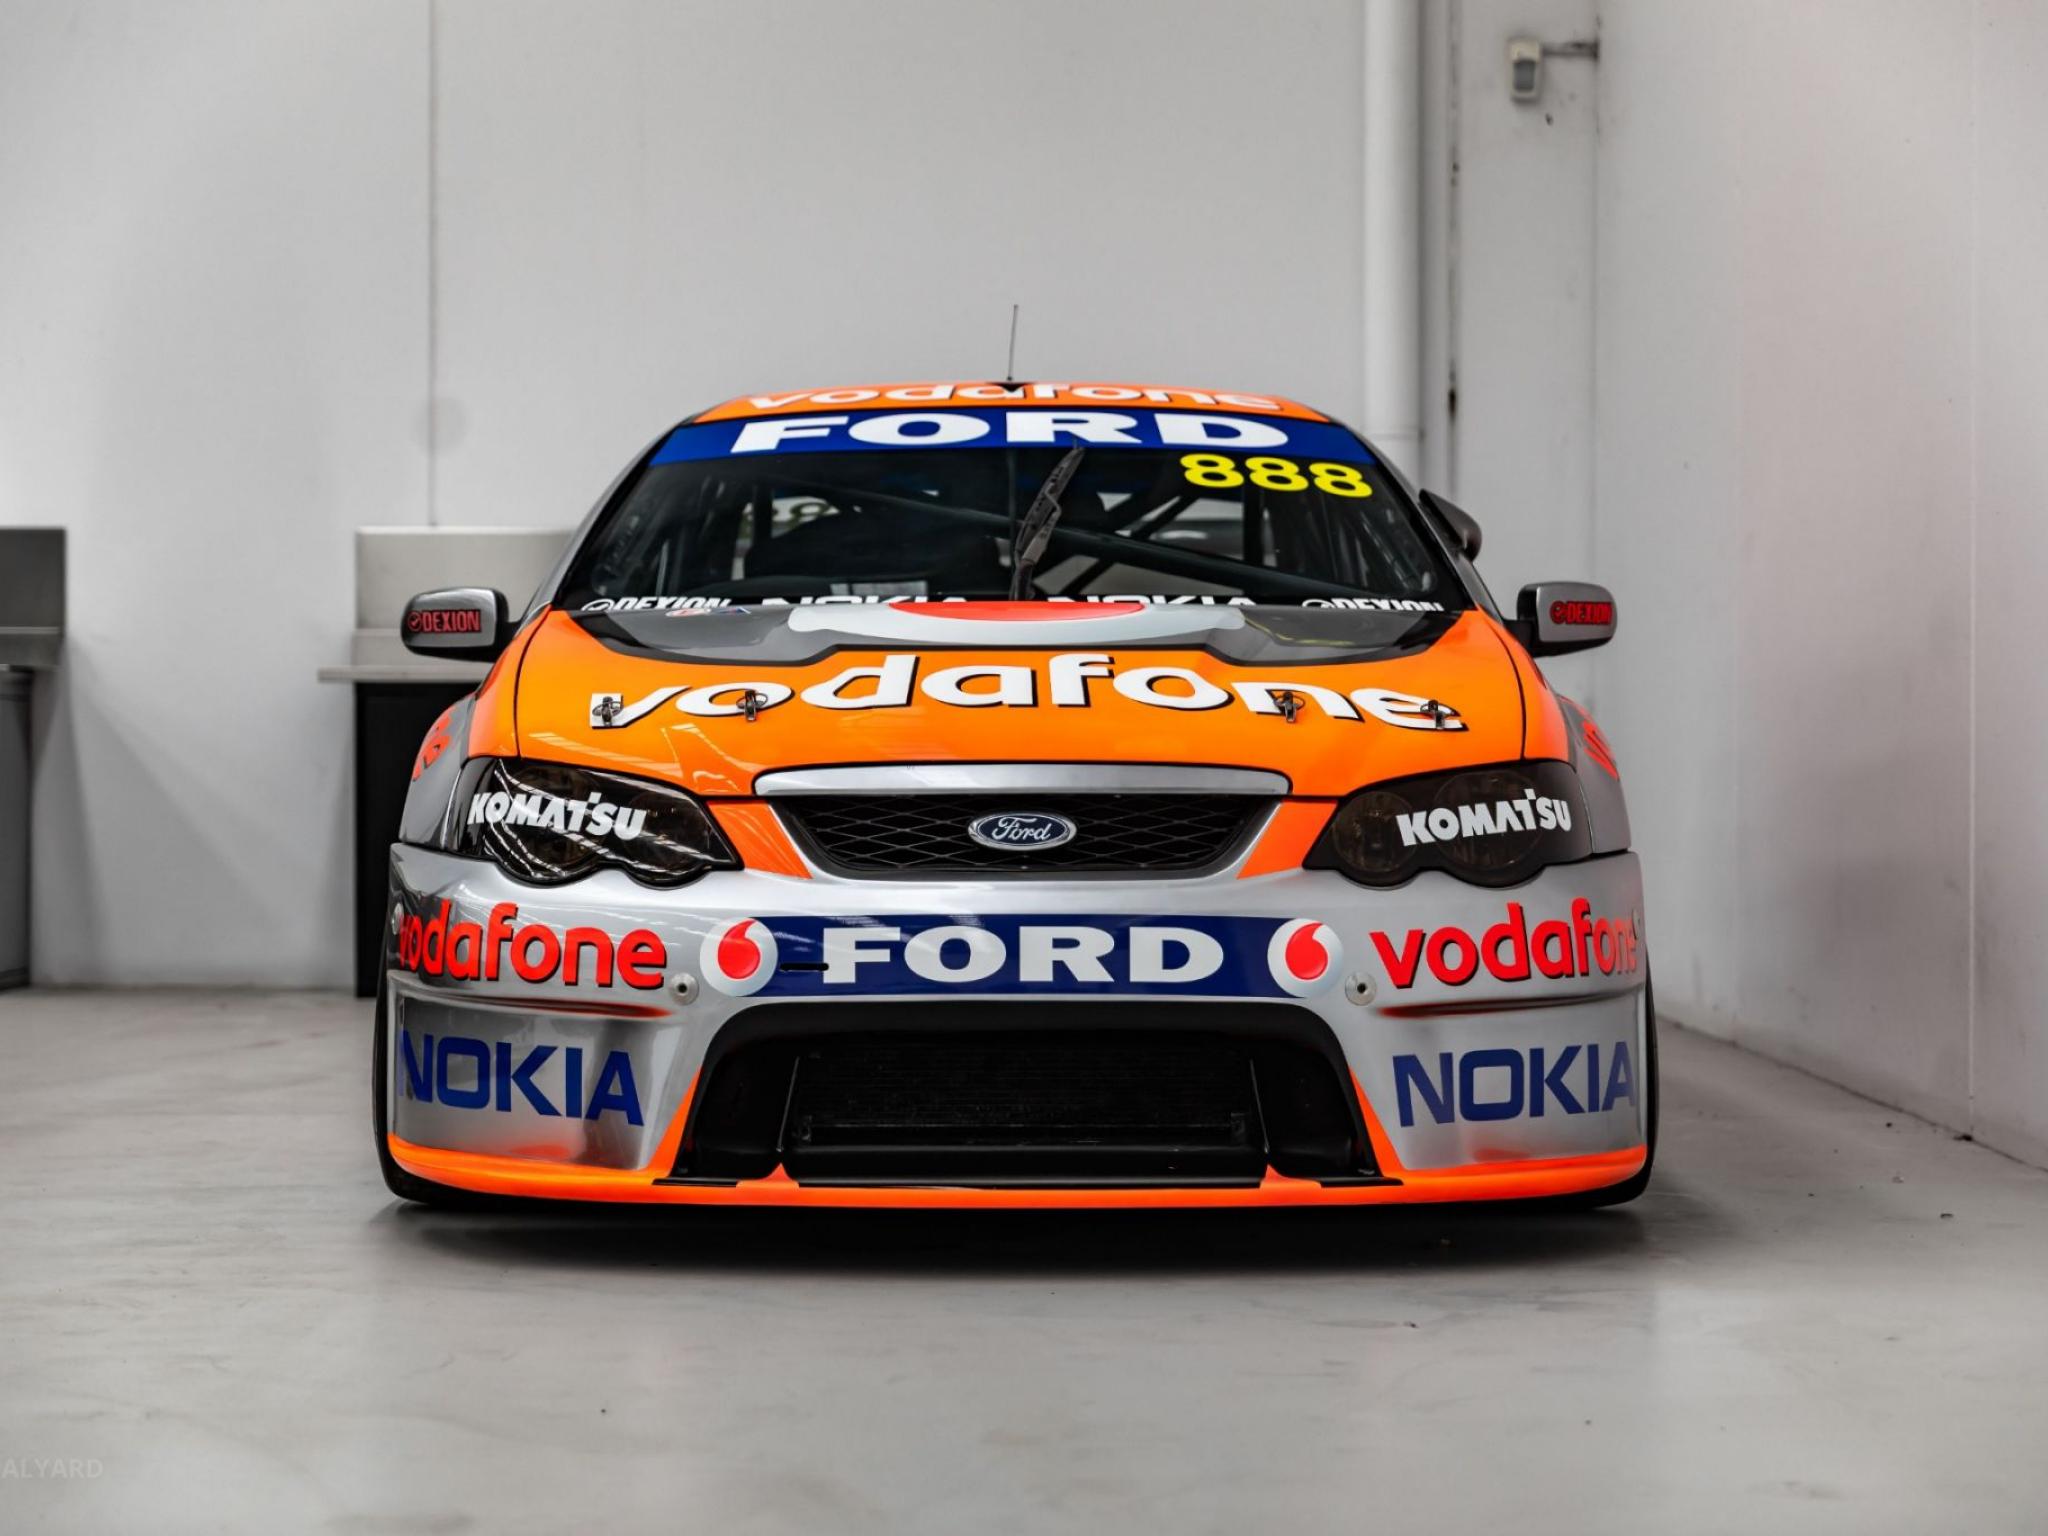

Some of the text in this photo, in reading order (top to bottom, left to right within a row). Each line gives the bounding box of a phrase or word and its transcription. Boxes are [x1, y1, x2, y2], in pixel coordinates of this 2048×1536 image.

[730, 412, 1290, 454] FORD
[1180, 453, 1373, 498] 888
[421, 610, 481, 633] DEXION
[589, 653, 1469, 732] vodafone
[467, 791, 647, 840] KOMATSU
[991, 816, 1052, 841] Ford
[1396, 788, 1572, 847] KOMATSU
[822, 926, 1224, 984] FORD
[1369, 896, 1638, 990] vodafone
[399, 1028, 644, 1127] NOKIA
[1392, 1041, 1636, 1128] NOKIA
